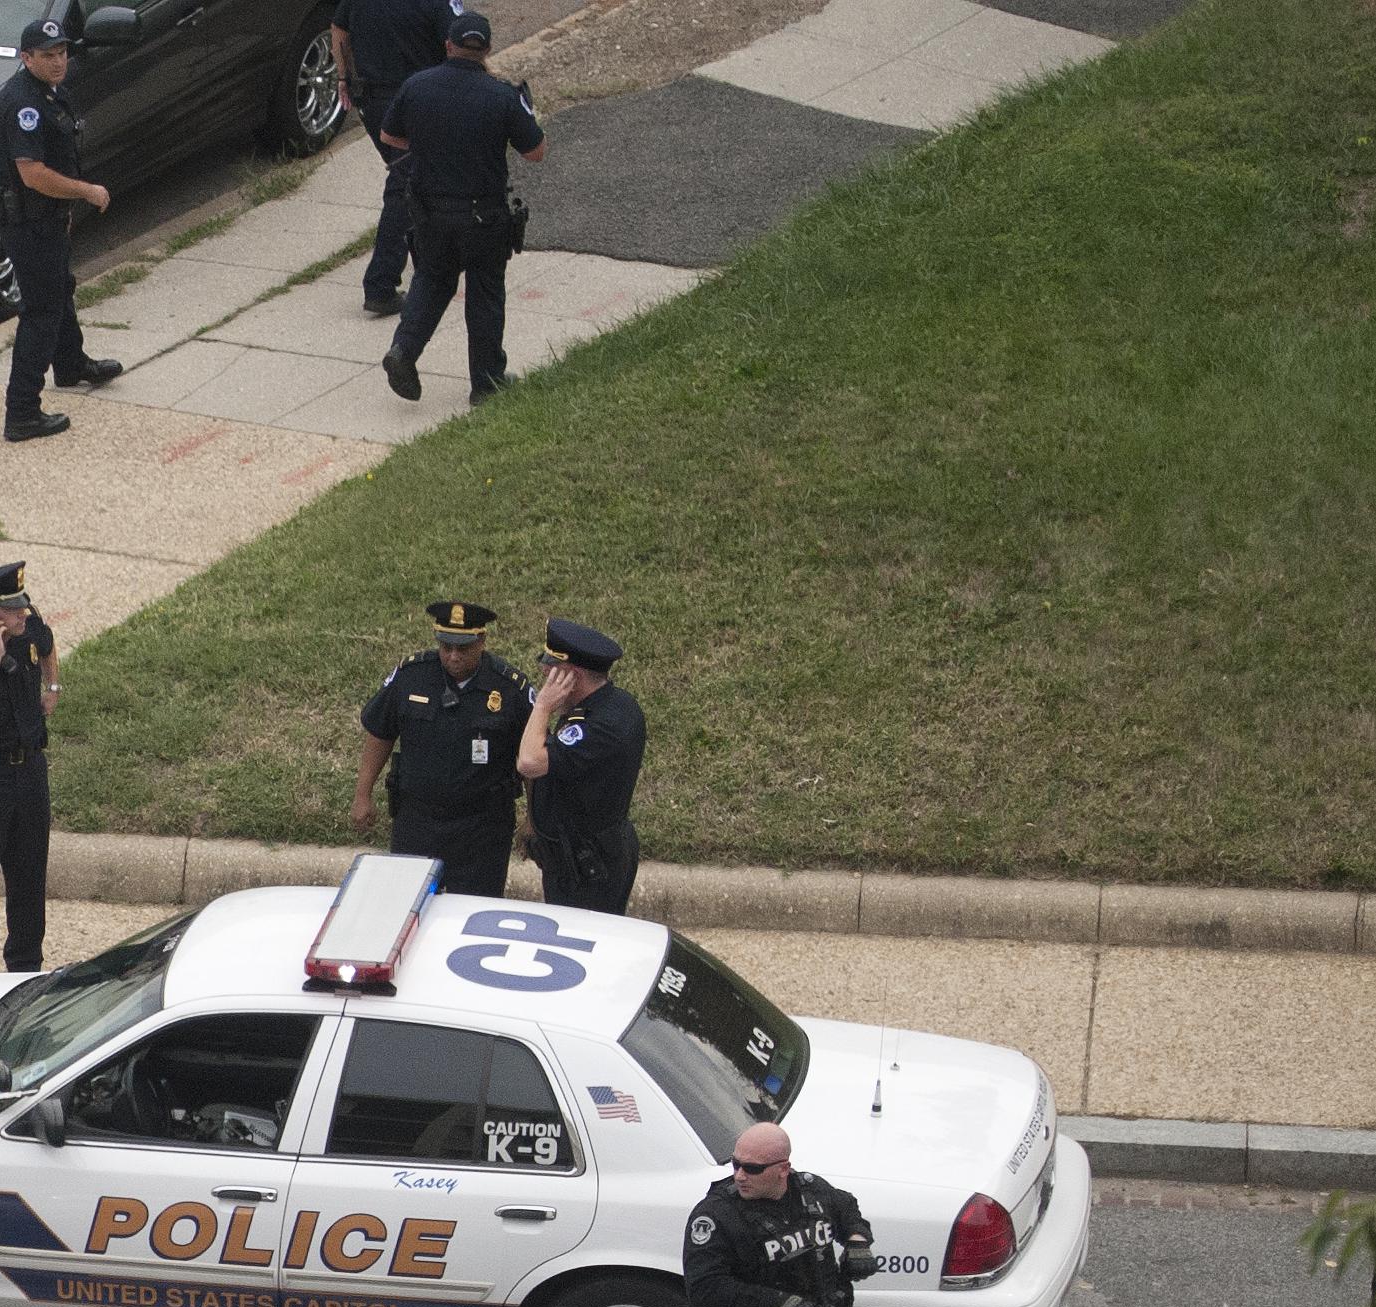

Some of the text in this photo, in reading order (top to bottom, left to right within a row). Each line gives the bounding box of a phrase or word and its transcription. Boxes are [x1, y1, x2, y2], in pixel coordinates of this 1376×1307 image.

[446, 909, 597, 993] CP
[658, 966, 687, 998] 1193
[746, 1027, 775, 1067] K-9
[483, 1121, 561, 1138] CAUTION
[487, 1135, 558, 1166] K-9
[85, 1195, 458, 1279] POLICE
[56, 1279, 158, 1307] UNITED
